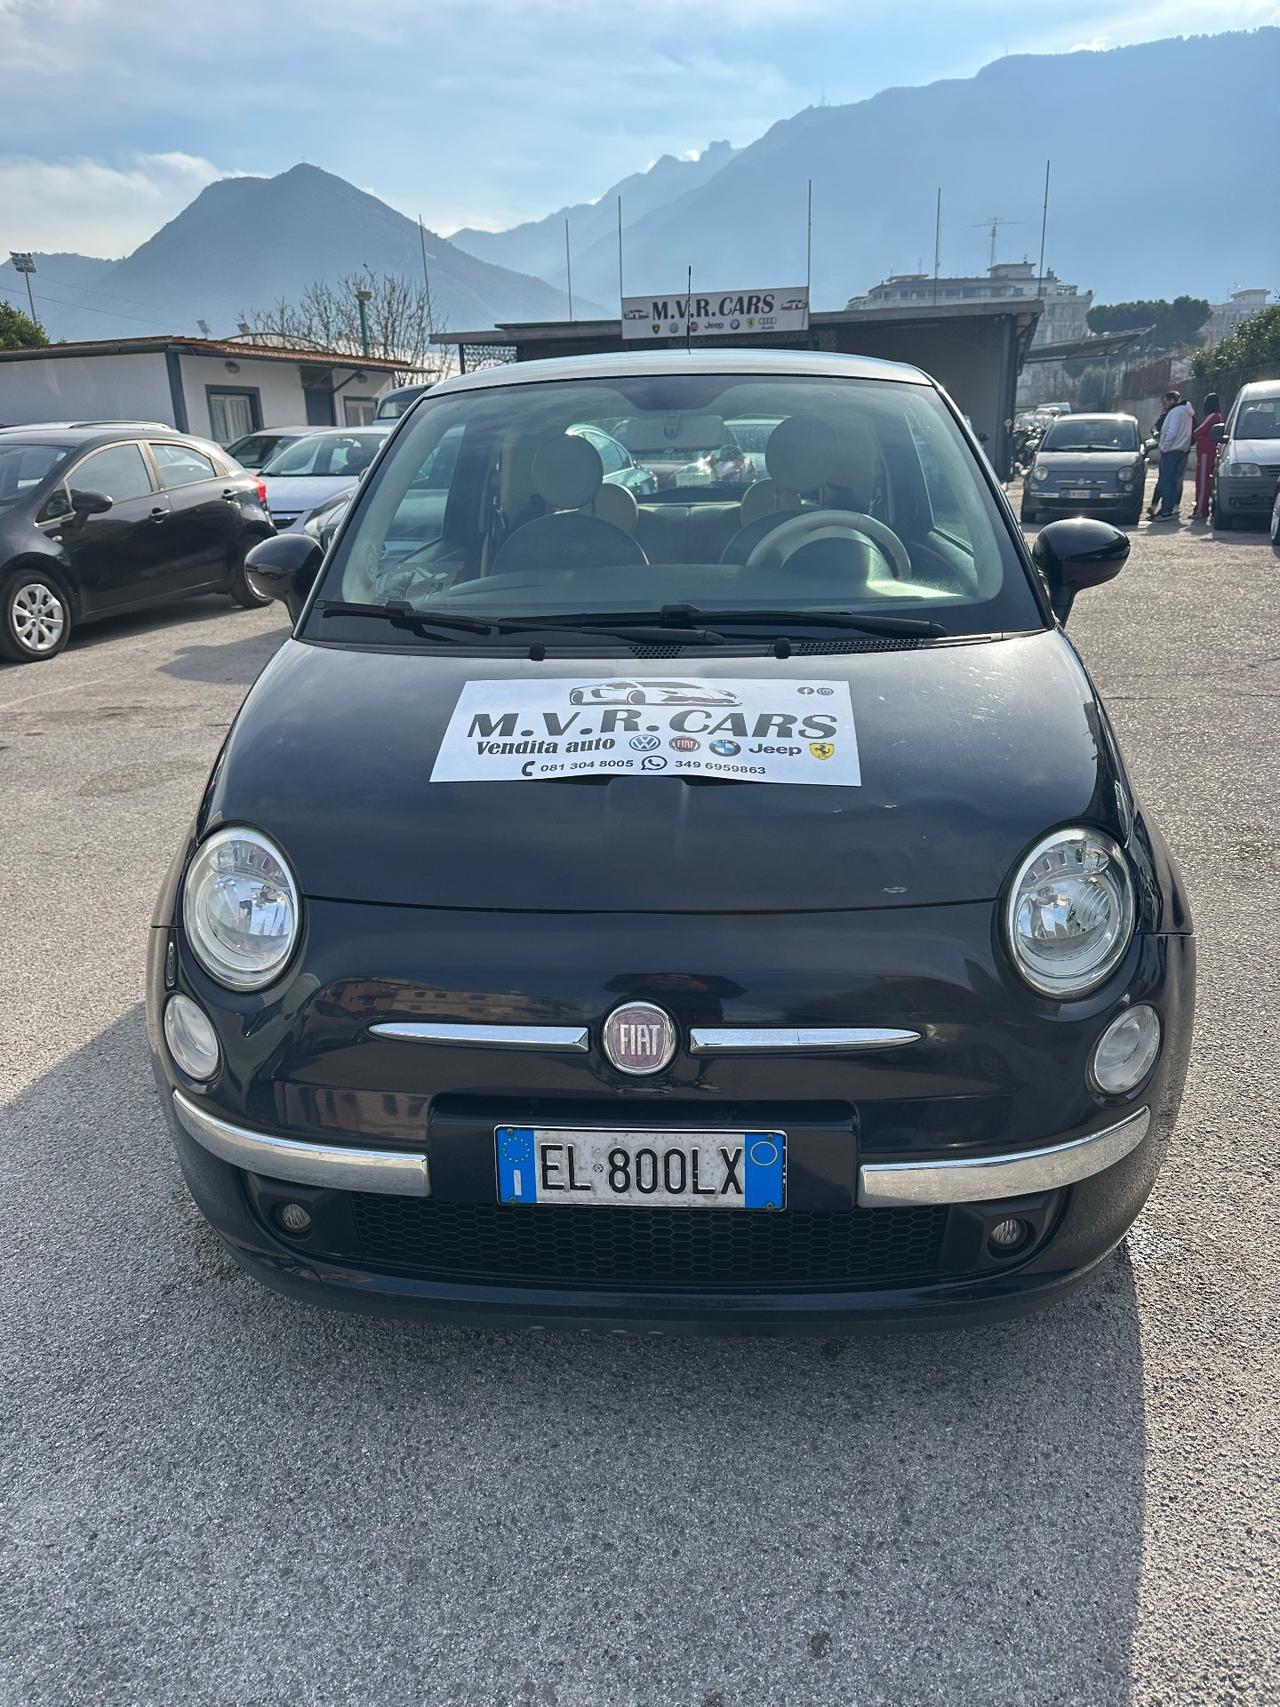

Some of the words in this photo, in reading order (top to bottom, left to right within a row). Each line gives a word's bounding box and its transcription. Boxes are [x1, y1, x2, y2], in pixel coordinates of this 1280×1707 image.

[719, 294, 775, 316] CARS
[704, 321, 724, 330] Jeep
[467, 709, 660, 738] M.V.R.
[669, 709, 838, 739] CARS
[477, 740, 559, 755] Vendita
[565, 738, 616, 753] auto
[676, 740, 695, 749] FIAT
[748, 743, 802, 756] Jeep
[540, 764, 565, 772] 081
[570, 761, 595, 770] 304
[599, 760, 634, 768] 8005
[675, 760, 702, 769] 349
[705, 762, 767, 775] 6959863
[619, 1024, 661, 1056] FIAT
[540, 1143, 591, 1191] EL
[608, 1147, 743, 1195] 800LX
